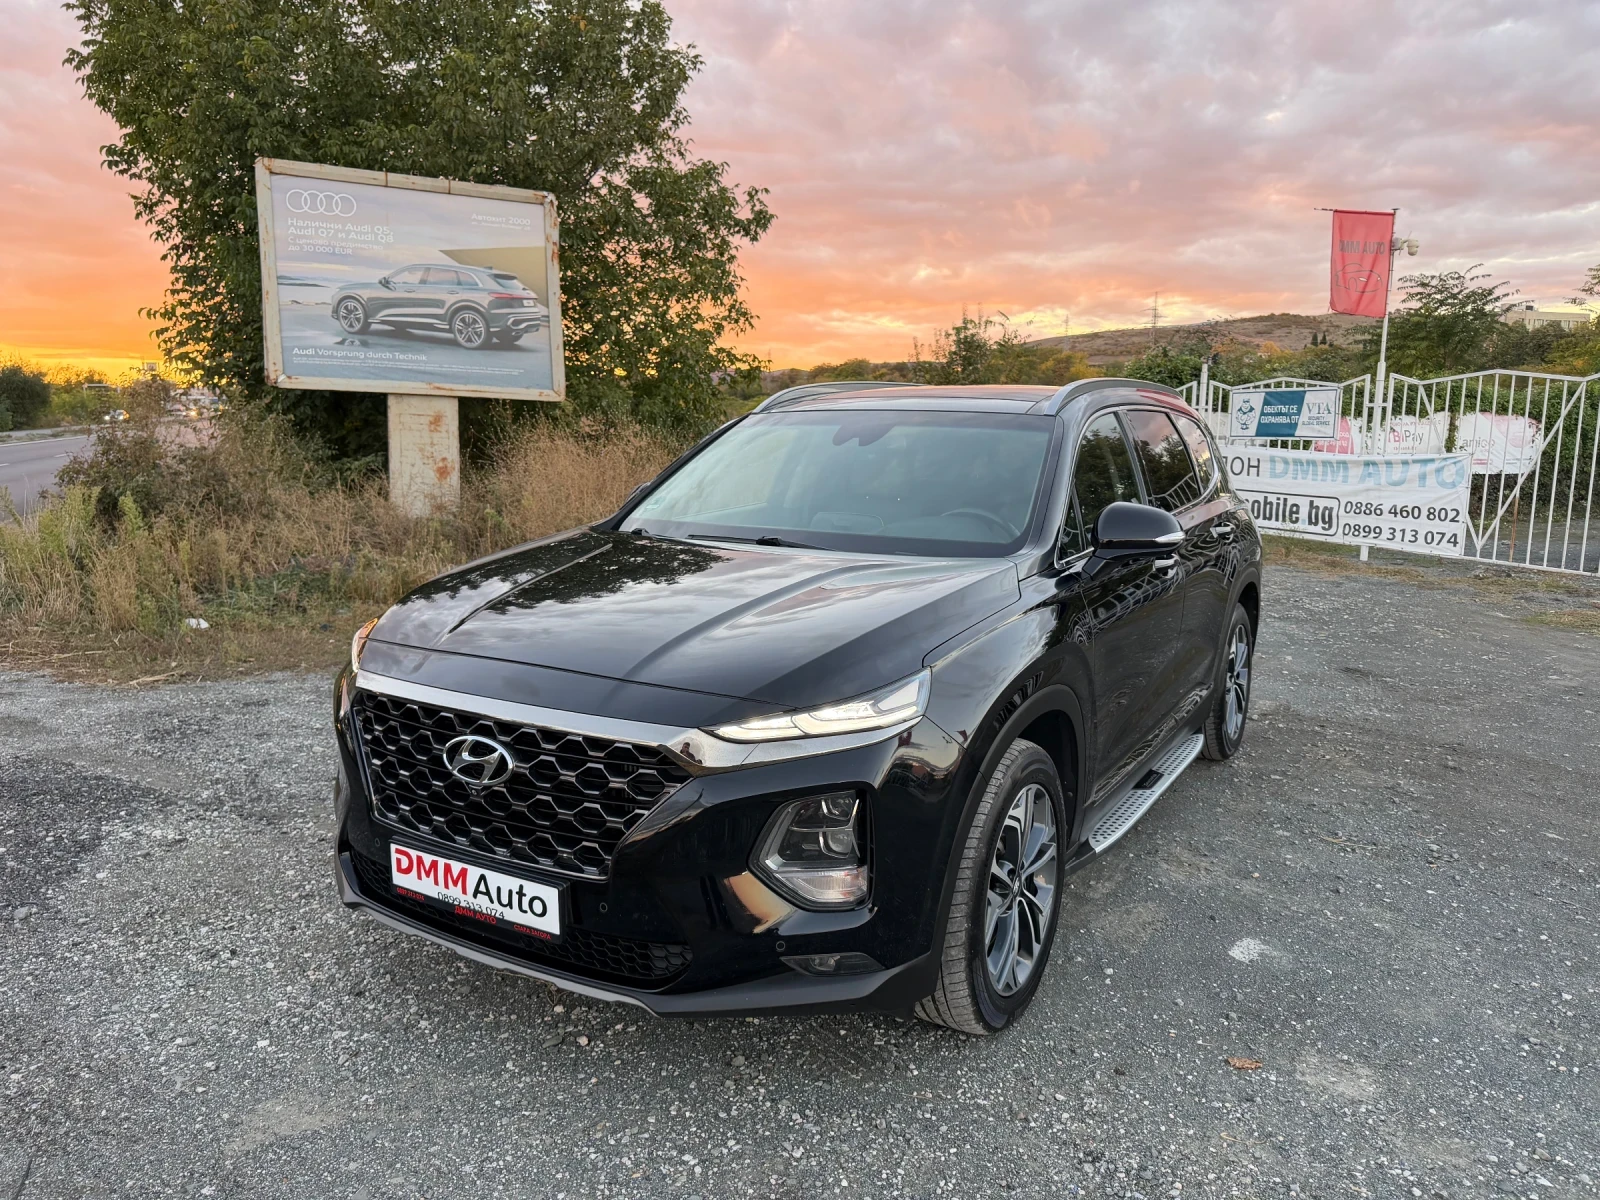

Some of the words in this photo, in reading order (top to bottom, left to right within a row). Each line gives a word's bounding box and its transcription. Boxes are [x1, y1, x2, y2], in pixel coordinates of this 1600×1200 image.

[288, 217, 342, 229] Налични
[345, 223, 371, 233] Audi
[374, 225, 394, 236] Q5,
[508, 216, 531, 226] 2000
[288, 226, 315, 236] Audi
[318, 228, 335, 237] Q7
[349, 231, 375, 241] Audi
[377, 234, 394, 244] Q8
[302, 244, 314, 252] 30
[315, 245, 333, 254] 000
[335, 247, 353, 255] EUR
[1362, 241, 1385, 255] AUTO
[292, 347, 315, 355] Audi
[316, 348, 365, 359] Vorsprung
[366, 351, 393, 359] durch
[394, 352, 428, 361] Technik
[1263, 405, 1289, 413] ОБЕКТЪТ
[1290, 405, 1298, 413] СЕ
[1306, 402, 1333, 415] VTA
[1260, 415, 1290, 424] ОХРАНЯВА
[1291, 415, 1299, 423] ОТ
[1269, 455, 1349, 484] DMM
[1358, 456, 1465, 490] AUTO
[1245, 495, 1335, 531] obile.bg
[1343, 500, 1384, 517] 0886
[1388, 504, 1422, 519] 460
[1426, 506, 1460, 523] 802
[1342, 522, 1383, 539] 0899
[1386, 527, 1419, 543] 313
[1424, 530, 1459, 548] 074
[437, 891, 461, 906] 0899
[463, 899, 483, 912] 313
[486, 906, 505, 919] 074
[454, 905, 474, 917] ДММ
[475, 912, 497, 925] АУТО
[513, 924, 531, 934] СТАРА
[531, 929, 552, 940] ЗАГОРА
